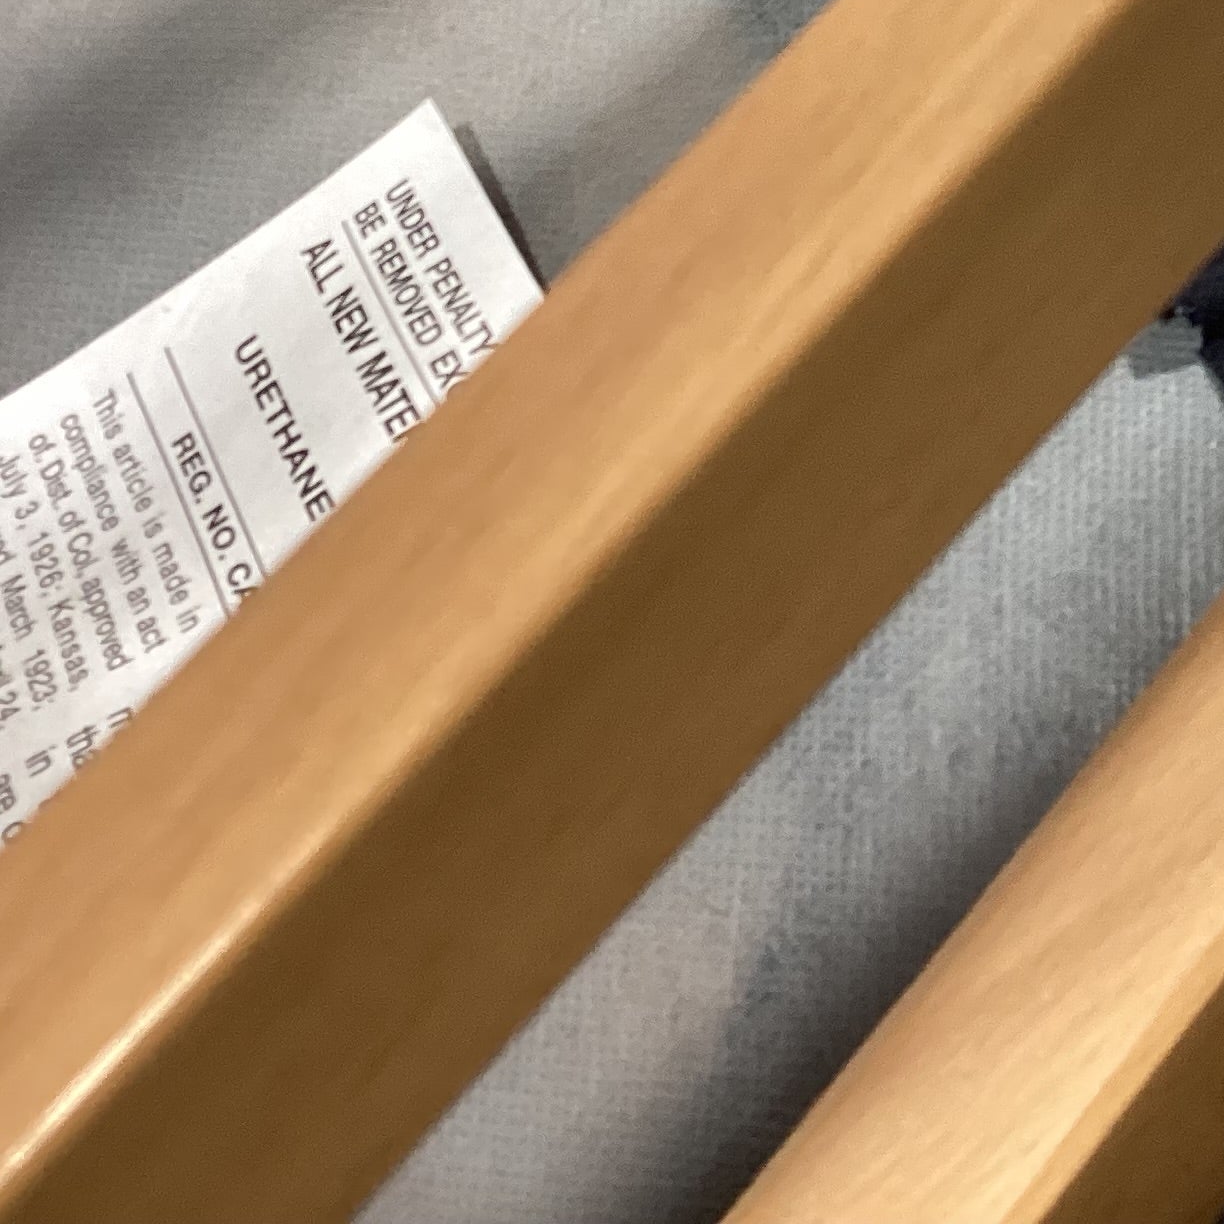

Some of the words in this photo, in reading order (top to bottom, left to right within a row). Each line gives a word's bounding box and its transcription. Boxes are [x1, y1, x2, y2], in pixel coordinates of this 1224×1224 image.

[354, 201, 387, 238] BE
[371, 238, 442, 345] REMOVED
[387, 178, 440, 258] UNDER
[426, 257, 497, 355] PENALTY
[301, 239, 343, 293] ALL
[326, 286, 379, 354] NEW
[356, 350, 421, 443] MATE
[93, 388, 125, 440] This
[235, 334, 335, 521] URETHANE
[60, 413, 119, 532] compliance
[113, 443, 154, 512] article
[172, 432, 211, 504] REG.
[202, 504, 235, 560] NO.
[143, 511, 165, 539] is
[111, 538, 143, 585] with
[153, 542, 192, 606] made
[0, 574, 37, 642] March
[80, 577, 136, 671] approved
[127, 586, 150, 615] an
[176, 605, 202, 633] in
[136, 616, 169, 654] act
